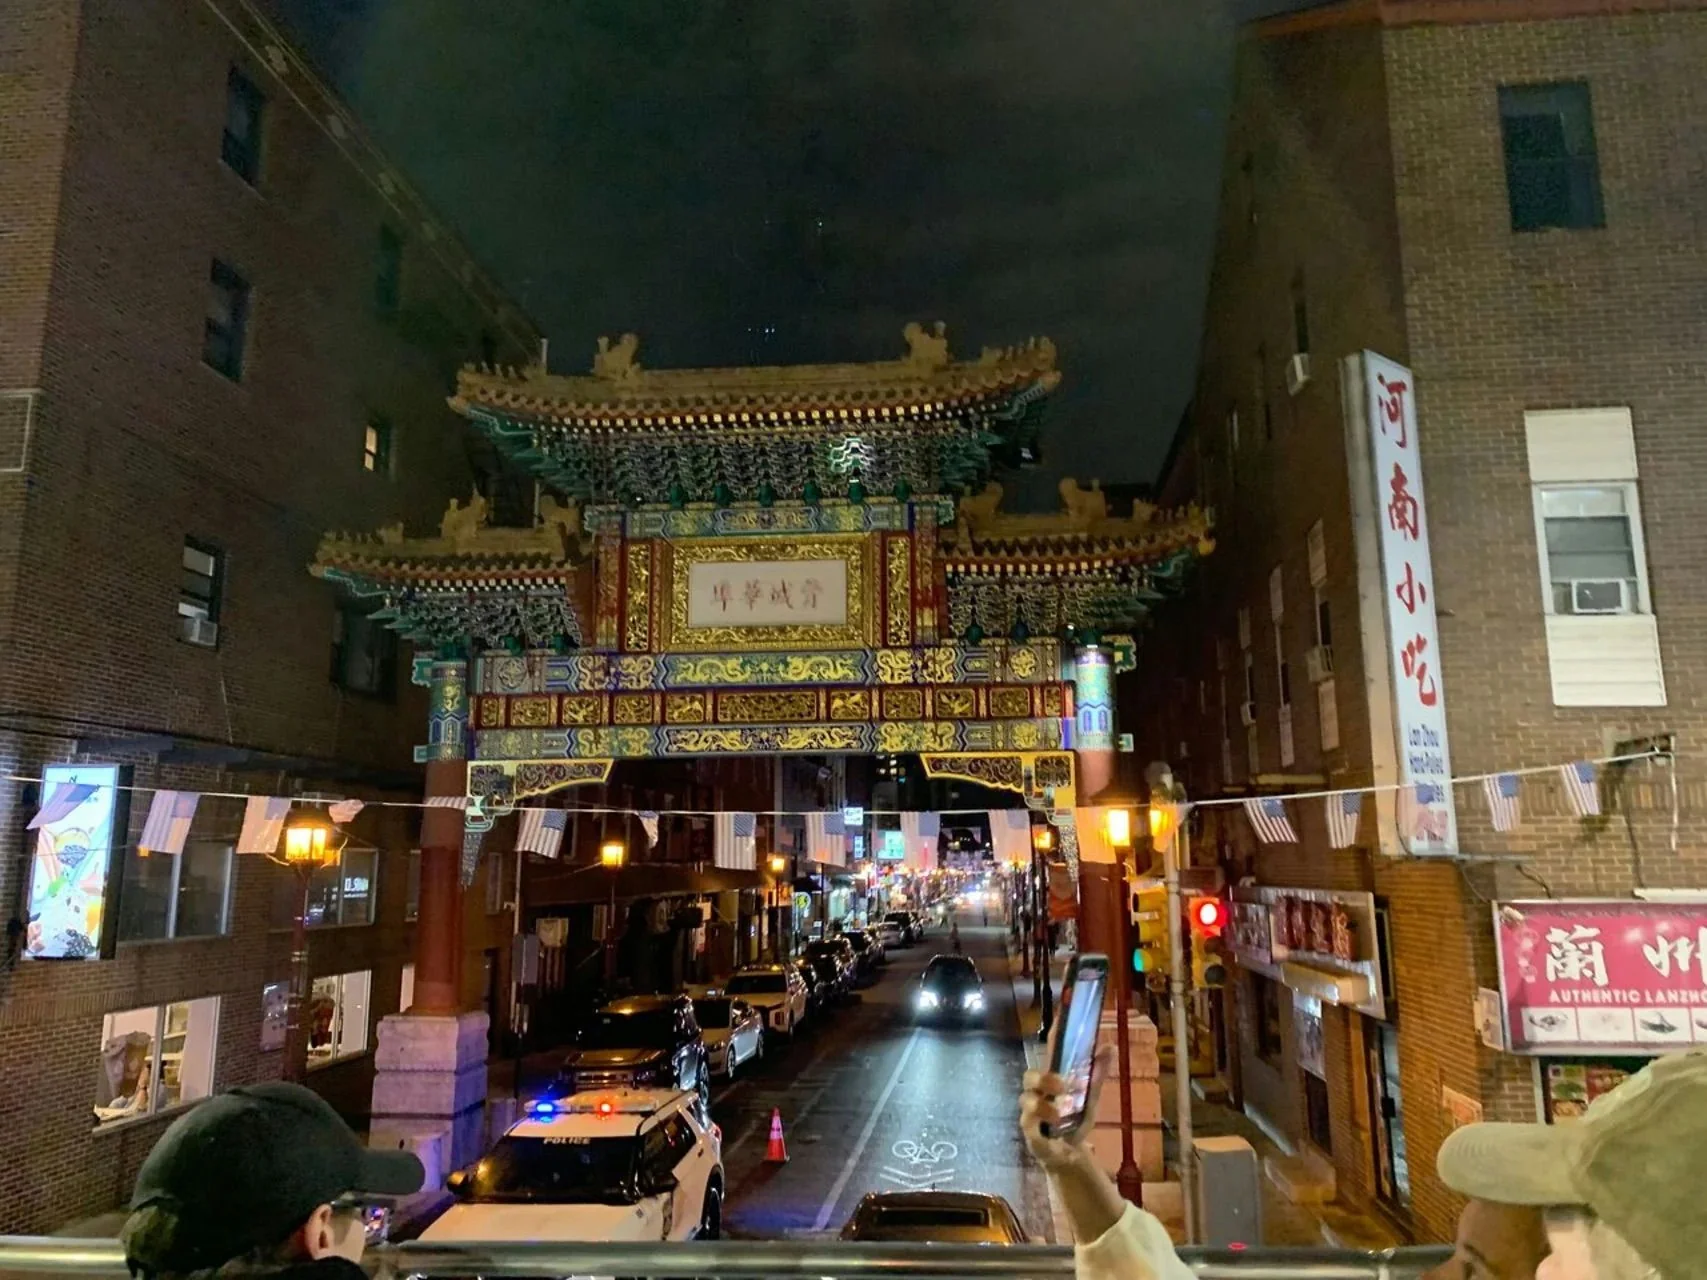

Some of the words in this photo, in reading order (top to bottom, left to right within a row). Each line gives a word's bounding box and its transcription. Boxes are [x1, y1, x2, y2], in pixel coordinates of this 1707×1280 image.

[1376, 371, 1437, 707] 河南小吃
[1549, 988, 1642, 1004] AUTHENTIC
[543, 1135, 591, 1145] POLICE
